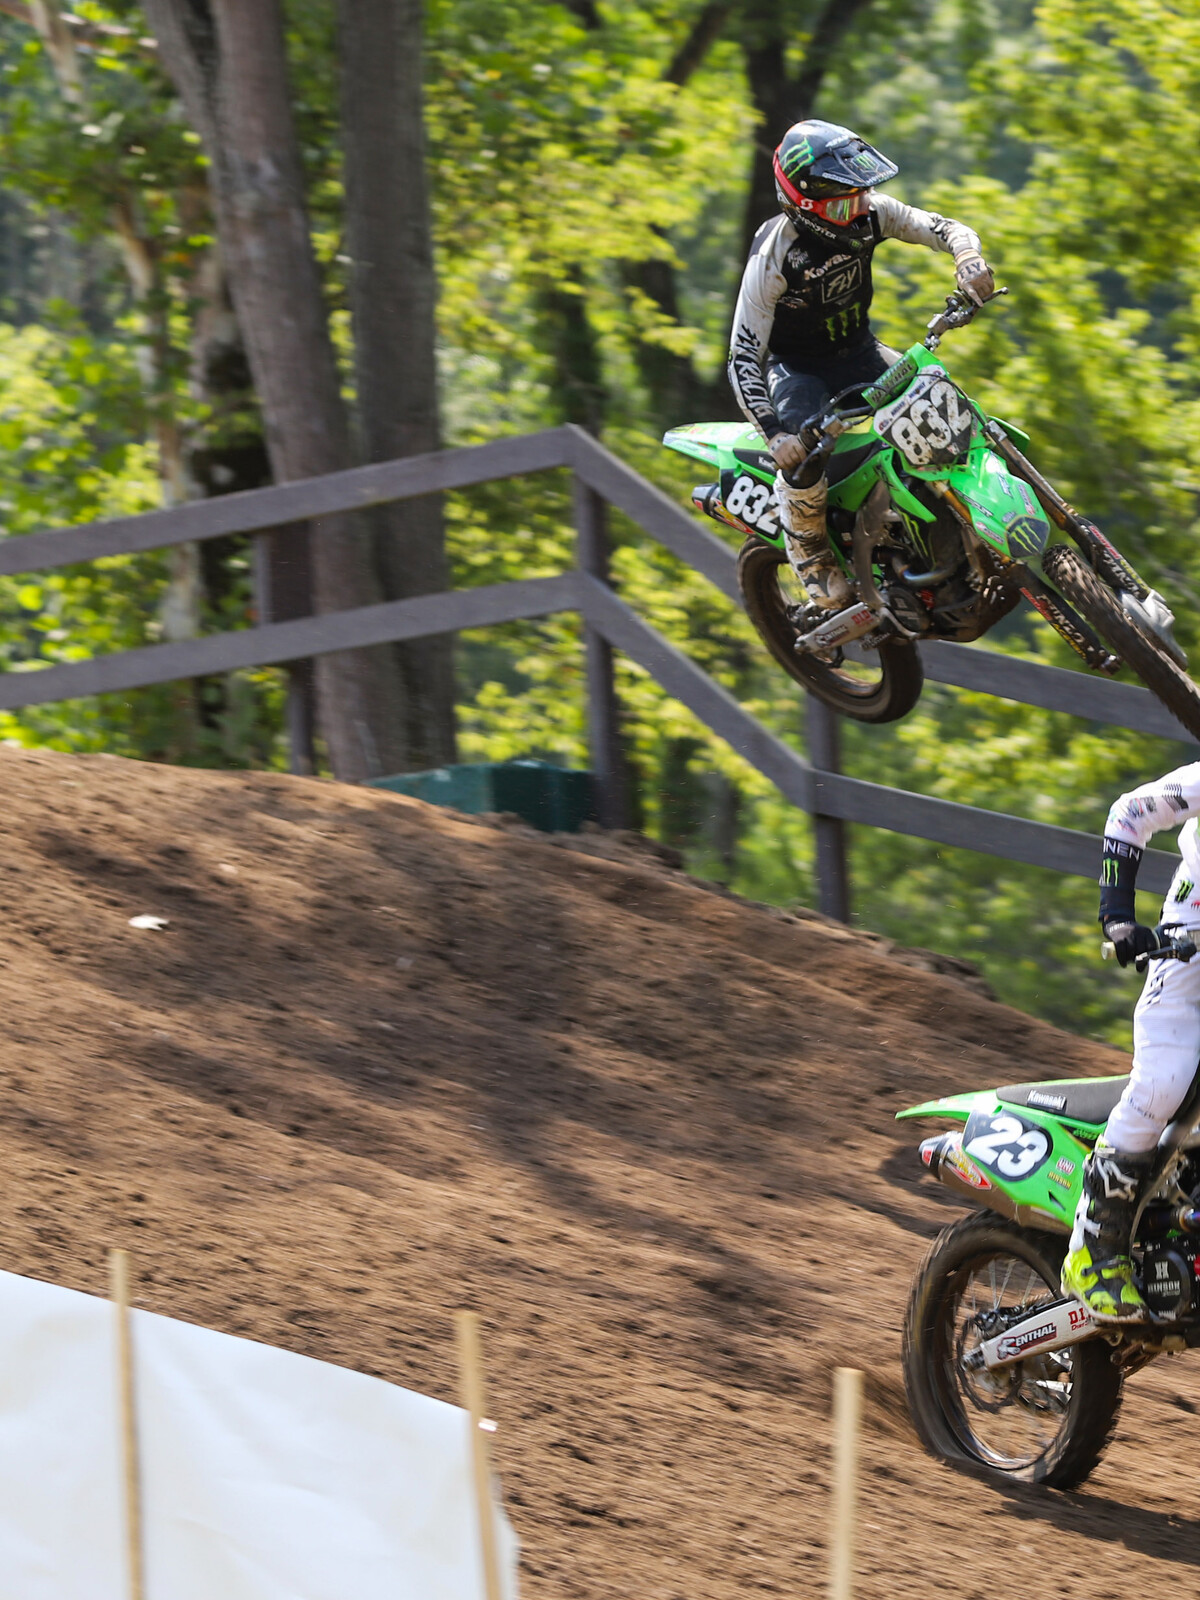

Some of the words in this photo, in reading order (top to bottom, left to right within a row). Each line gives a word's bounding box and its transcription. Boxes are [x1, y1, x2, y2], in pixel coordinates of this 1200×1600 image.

[826, 266, 857, 298] FLY
[959, 262, 981, 279] FLY
[890, 381, 972, 466] 832
[726, 475, 781, 536] 832
[1027, 1089, 1067, 1109] Kawasaki
[965, 1116, 1049, 1178] 23
[1058, 1159, 1074, 1174] UNI
